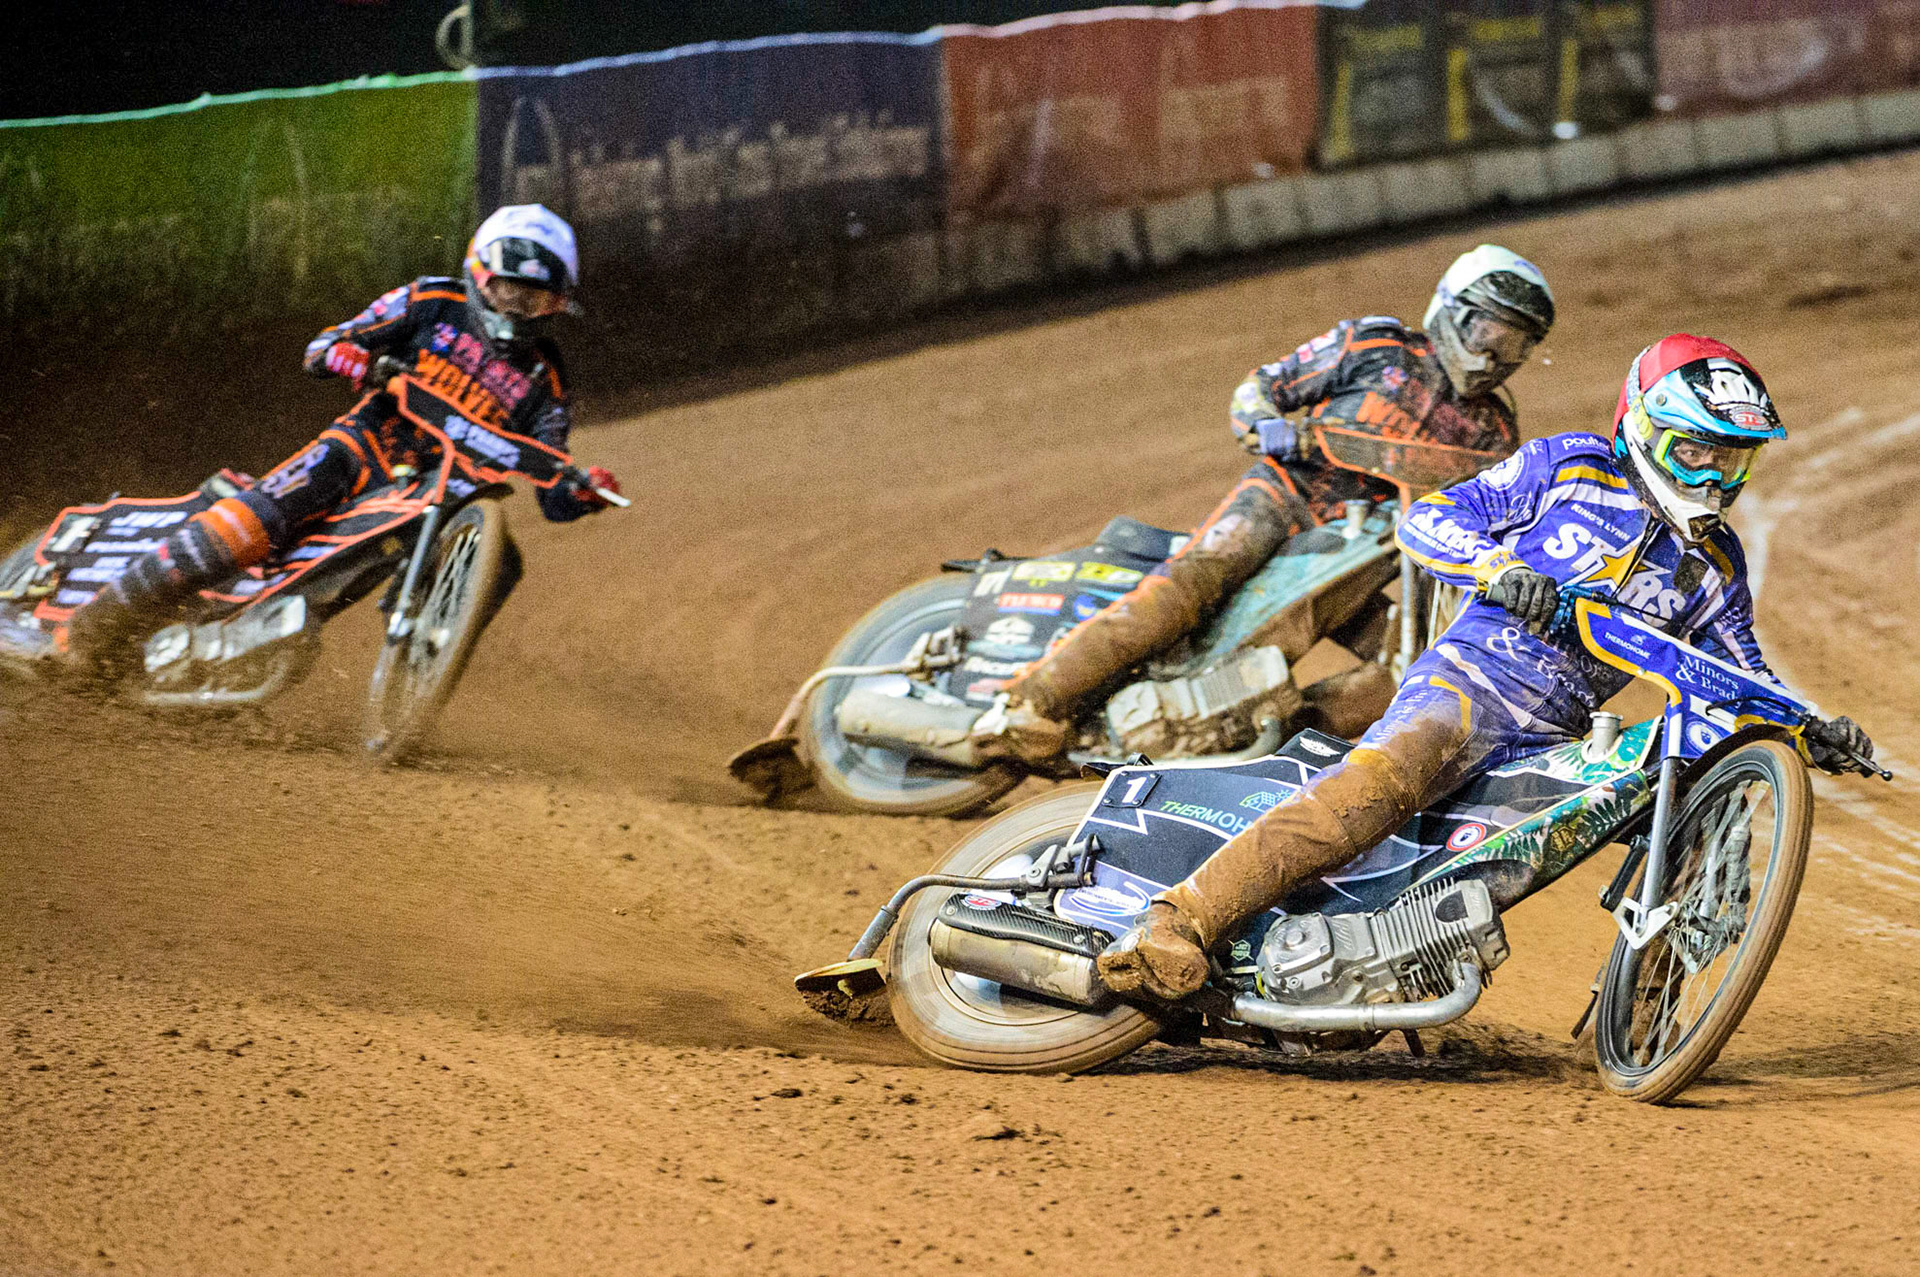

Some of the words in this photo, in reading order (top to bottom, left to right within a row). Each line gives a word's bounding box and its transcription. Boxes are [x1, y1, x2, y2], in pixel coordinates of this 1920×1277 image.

[1570, 504, 1604, 528] KING'S
[1604, 521, 1631, 543] LYNN
[1605, 631, 1651, 660] THERMOHOME
[1675, 661, 1697, 684] &
[1683, 655, 1739, 690] Minors
[1122, 776, 1147, 804] 1
